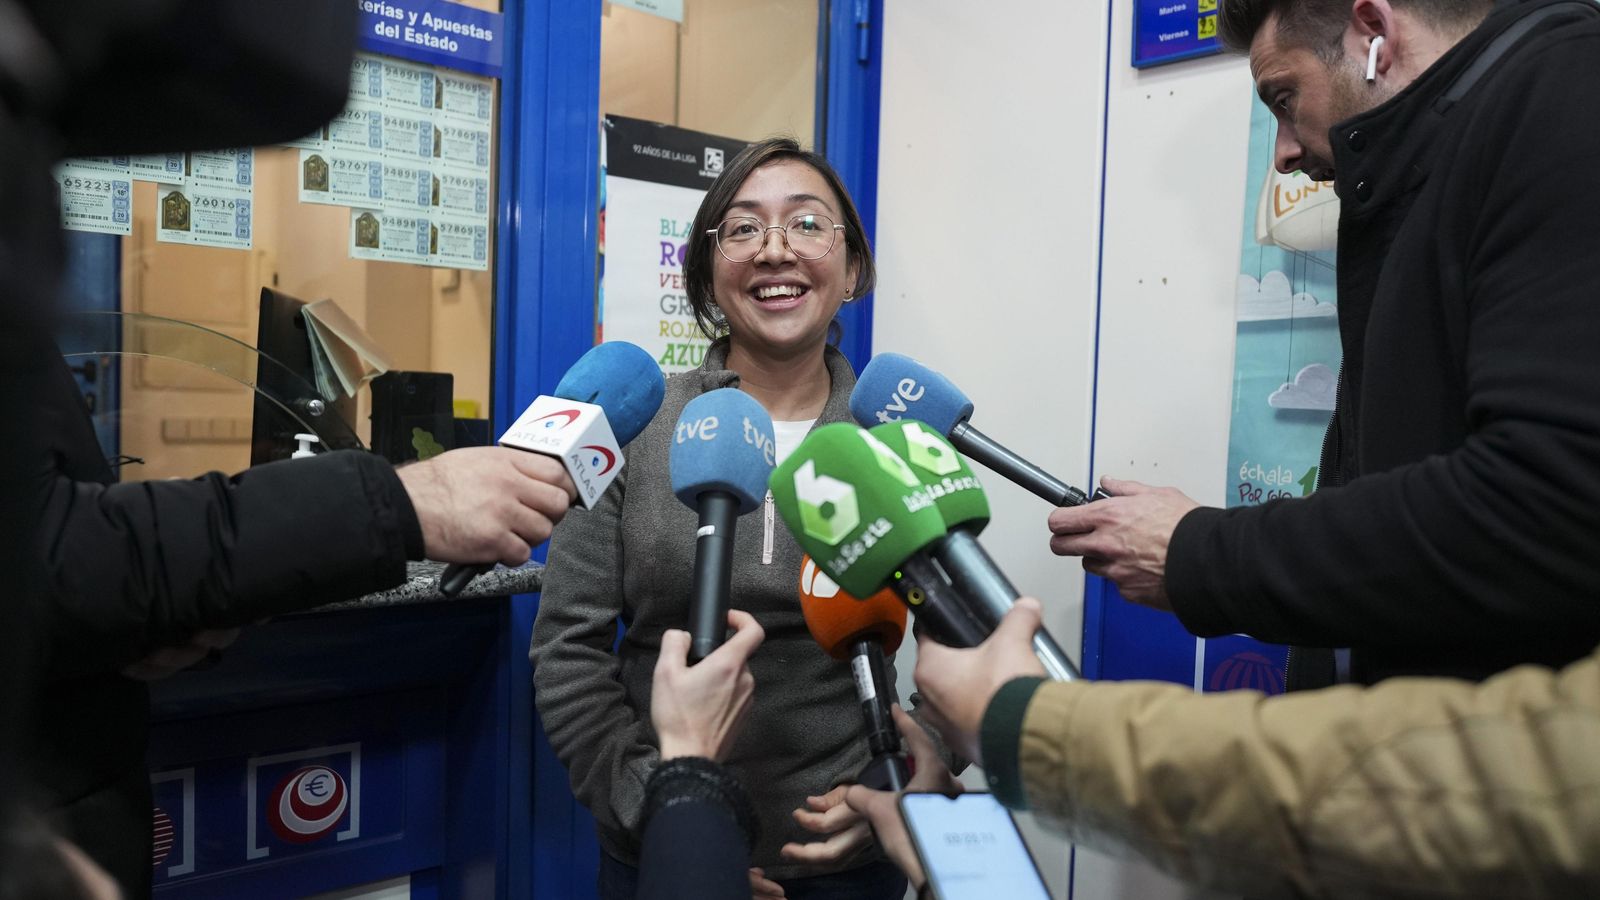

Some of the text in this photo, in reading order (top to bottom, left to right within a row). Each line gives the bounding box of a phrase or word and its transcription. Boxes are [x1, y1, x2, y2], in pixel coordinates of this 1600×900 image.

[1159, 4, 1187, 16] Martes
[408, 11, 418, 26] y
[422, 12, 493, 41] Apuestas
[1159, 17, 1216, 42] Viernes 23
[375, 21, 458, 52] del Estado
[385, 66, 420, 81] 94898
[384, 117, 418, 130] 94898
[443, 127, 476, 140] 57869
[642, 145, 661, 157] AÑOS
[661, 149, 671, 159] DE
[672, 152, 681, 161] LA
[681, 153, 697, 164] LIGA
[332, 159, 368, 172] 79767
[384, 167, 417, 180] 94898
[64, 178, 111, 191] 65223
[442, 175, 475, 188] 57869
[194, 197, 235, 209] 76016
[1274, 180, 1334, 218] LUN
[381, 216, 416, 229] 94898
[440, 223, 474, 235] 57869
[659, 343, 705, 367] AZU
[875, 377, 925, 424] tve
[675, 415, 719, 444] tve
[512, 431, 562, 447] ATLAS
[743, 416, 776, 466] tve
[571, 453, 598, 500] ATLAS
[1239, 460, 1293, 486] échala
